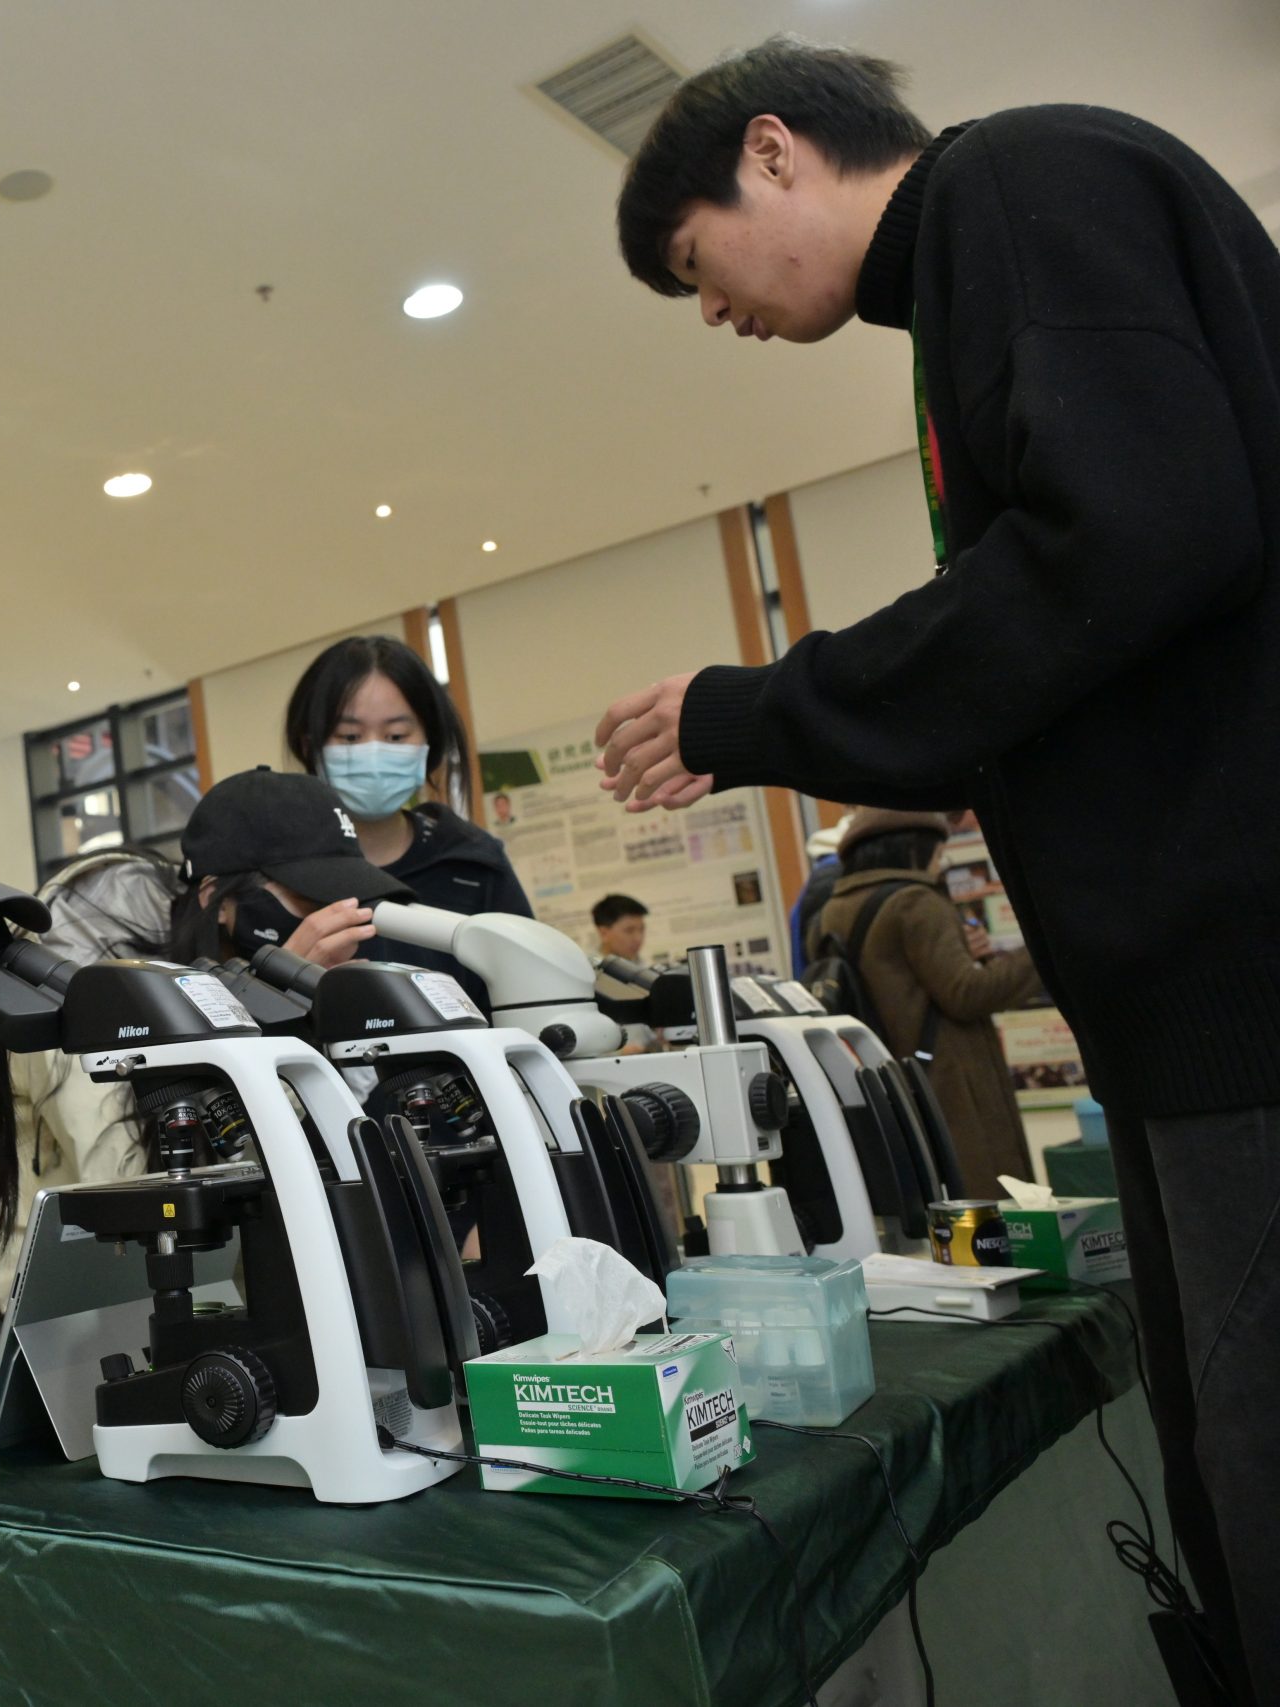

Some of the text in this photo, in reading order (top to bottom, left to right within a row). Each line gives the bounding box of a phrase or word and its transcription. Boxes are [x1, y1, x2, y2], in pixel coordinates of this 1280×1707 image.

[118, 1025, 150, 1039] Nikon
[365, 1018, 395, 1030] Nikon
[1080, 1230, 1125, 1250] KIMTEC
[513, 1374, 550, 1384] Kimwipes
[514, 1384, 614, 1403] KIMTECH
[686, 1388, 735, 1430] KIMTECH
